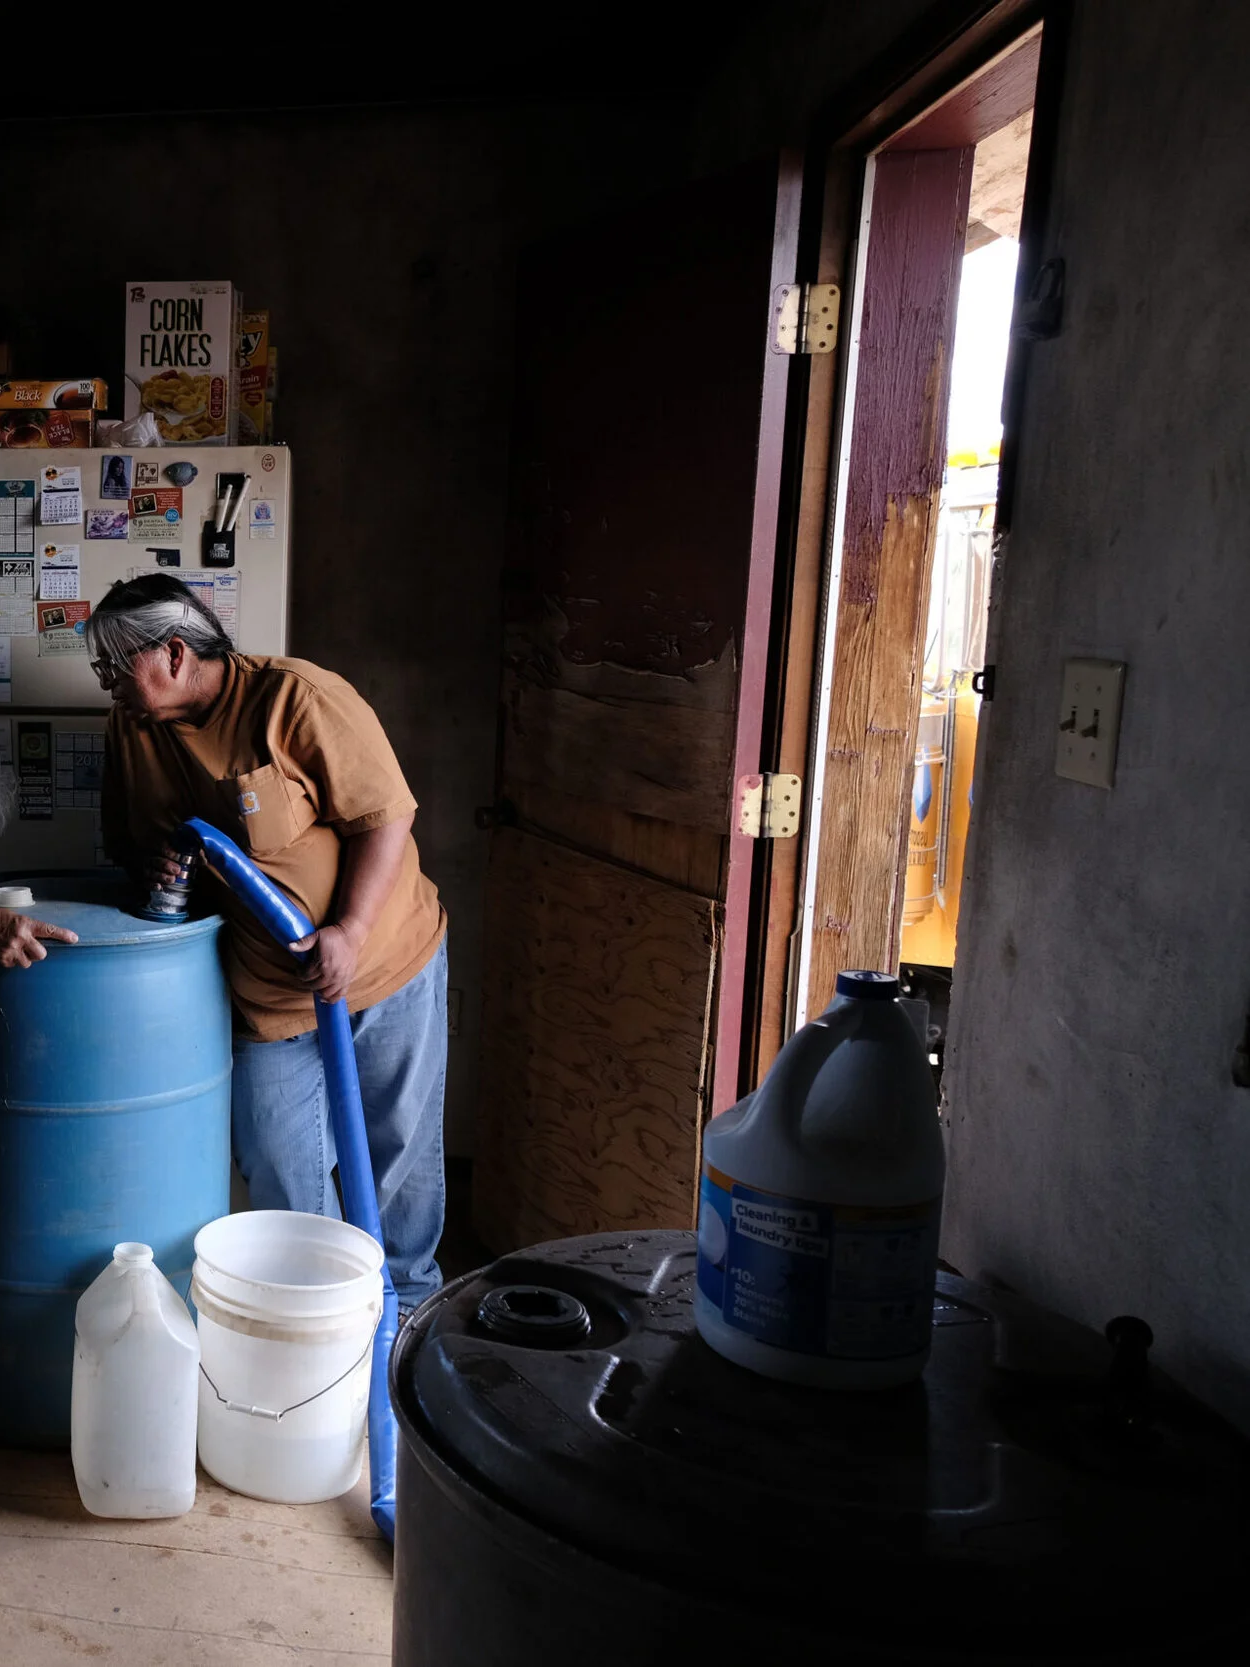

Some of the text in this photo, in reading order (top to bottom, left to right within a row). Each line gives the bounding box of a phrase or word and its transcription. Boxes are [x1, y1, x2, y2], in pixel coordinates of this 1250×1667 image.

[150, 299, 203, 331] CORN
[140, 334, 211, 367] FLAKES
[14, 389, 42, 401] Black
[735, 1204, 811, 1229] Cleaning &
[739, 1218, 791, 1247] laundry
